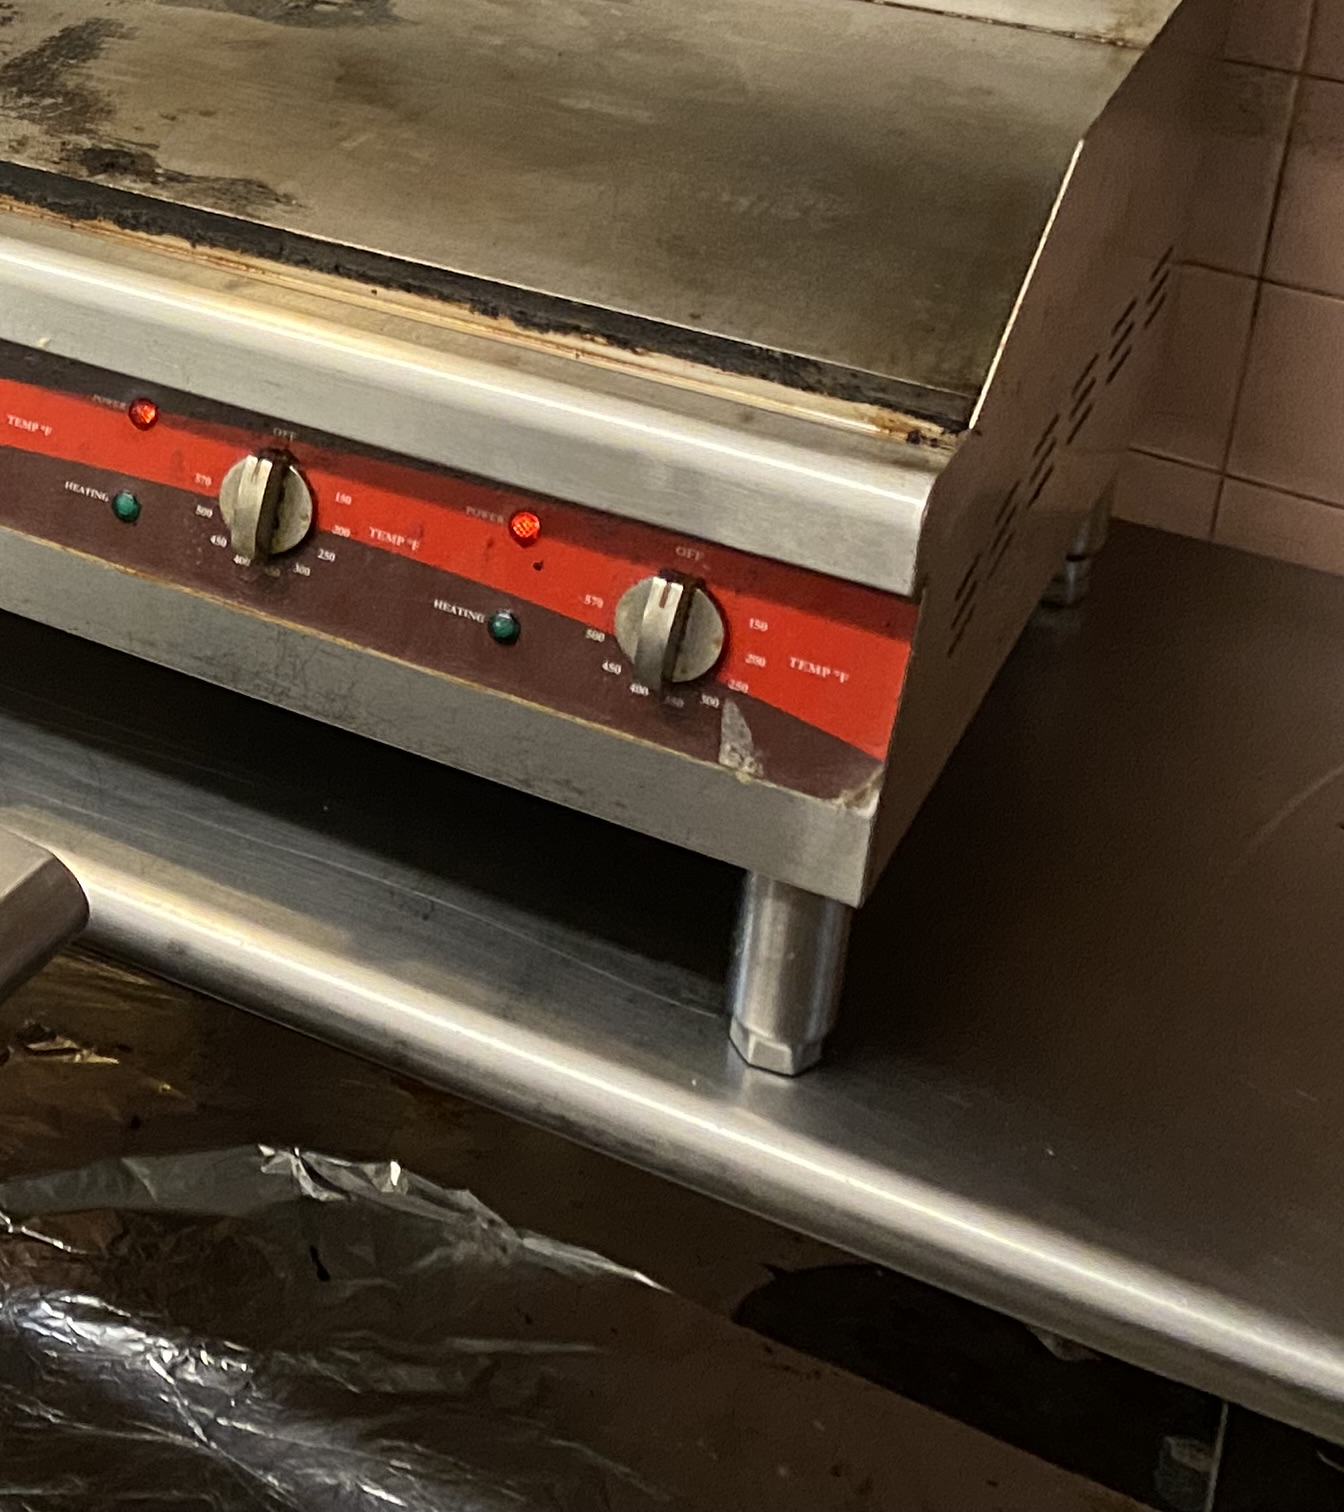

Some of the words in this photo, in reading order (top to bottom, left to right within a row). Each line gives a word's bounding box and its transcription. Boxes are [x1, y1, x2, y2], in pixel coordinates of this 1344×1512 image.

[7, 413, 39, 433] TEMP
[65, 480, 110, 503] HEATING
[335, 492, 352, 506] 150
[195, 504, 213, 519] 500
[210, 534, 227, 548] 450
[368, 526, 405, 548] TEMP
[233, 554, 250, 567] 400
[317, 548, 336, 563] 250
[675, 545, 705, 561] OFF
[294, 563, 311, 577] 300
[433, 598, 486, 624] HEATING
[749, 617, 768, 632] 150
[585, 628, 606, 643] 500
[602, 660, 622, 675] 450
[745, 653, 766, 667] 200
[789, 656, 831, 678] TEMP
[630, 683, 649, 696] 400
[728, 678, 749, 694] 250
[700, 693, 720, 709] 300
